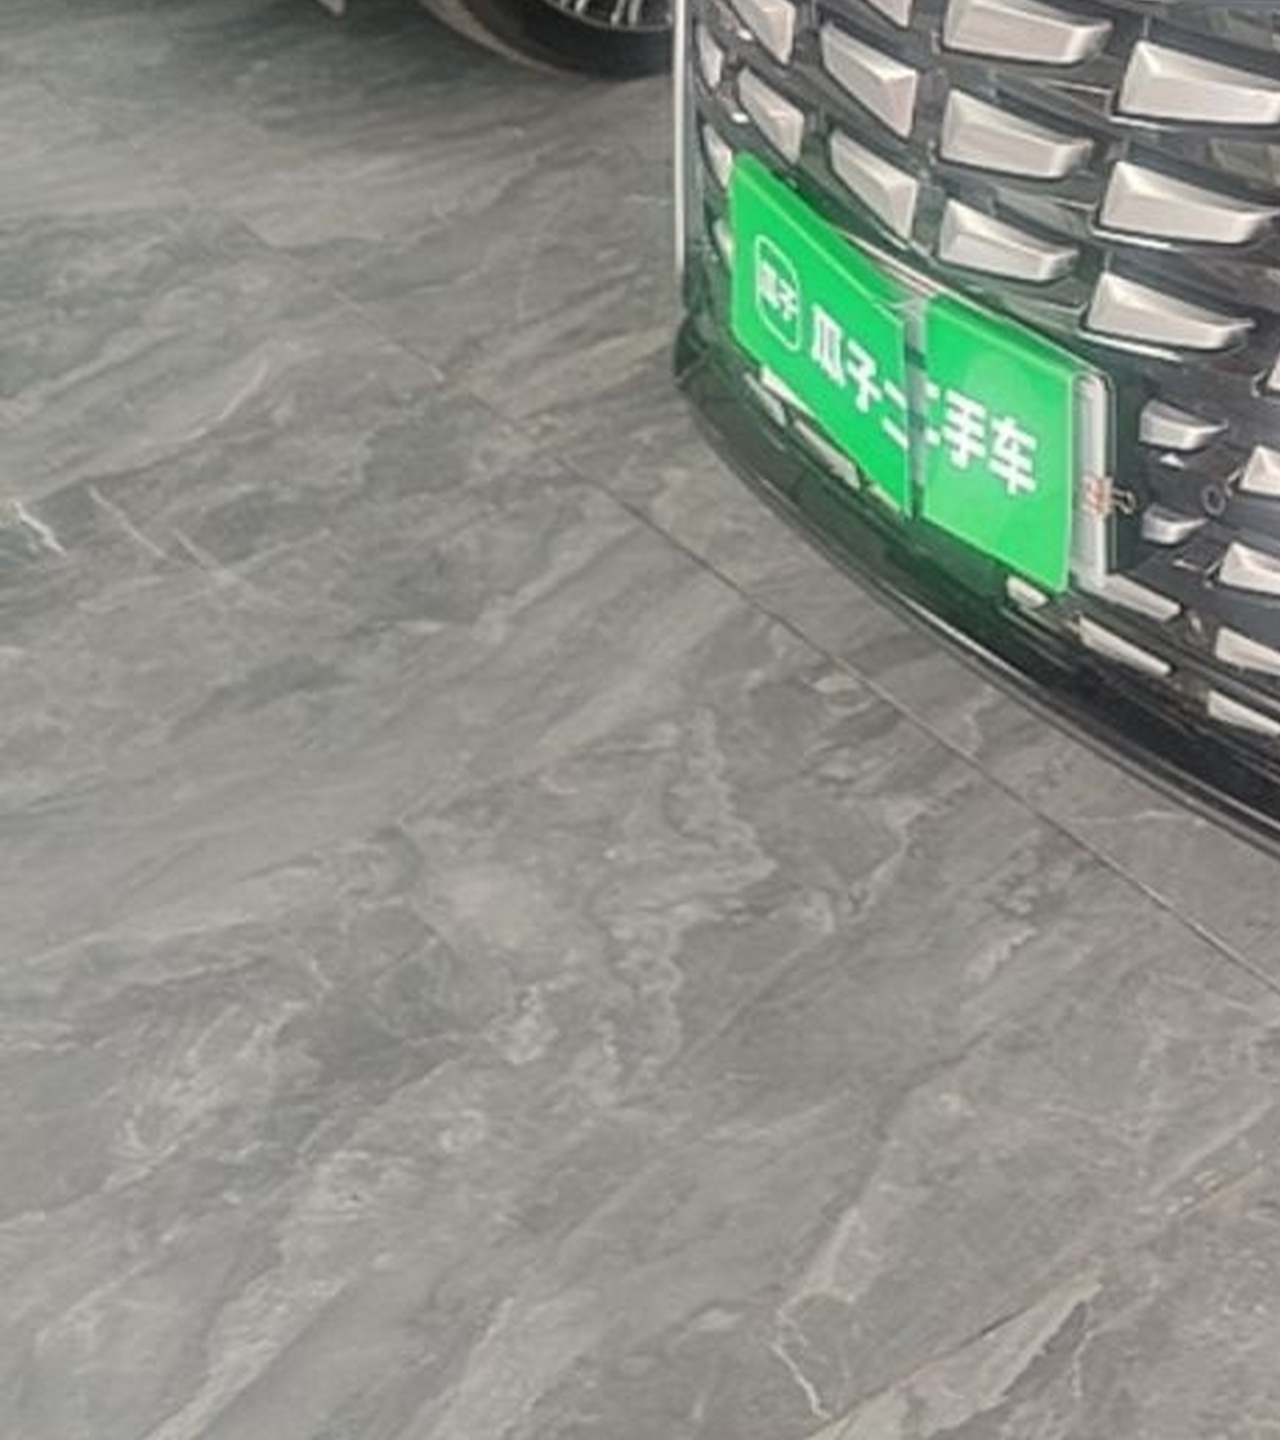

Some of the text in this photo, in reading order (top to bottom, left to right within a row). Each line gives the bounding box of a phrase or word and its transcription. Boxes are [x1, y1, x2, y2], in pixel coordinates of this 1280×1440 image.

[812, 302, 1037, 496] 瓜子二手车
